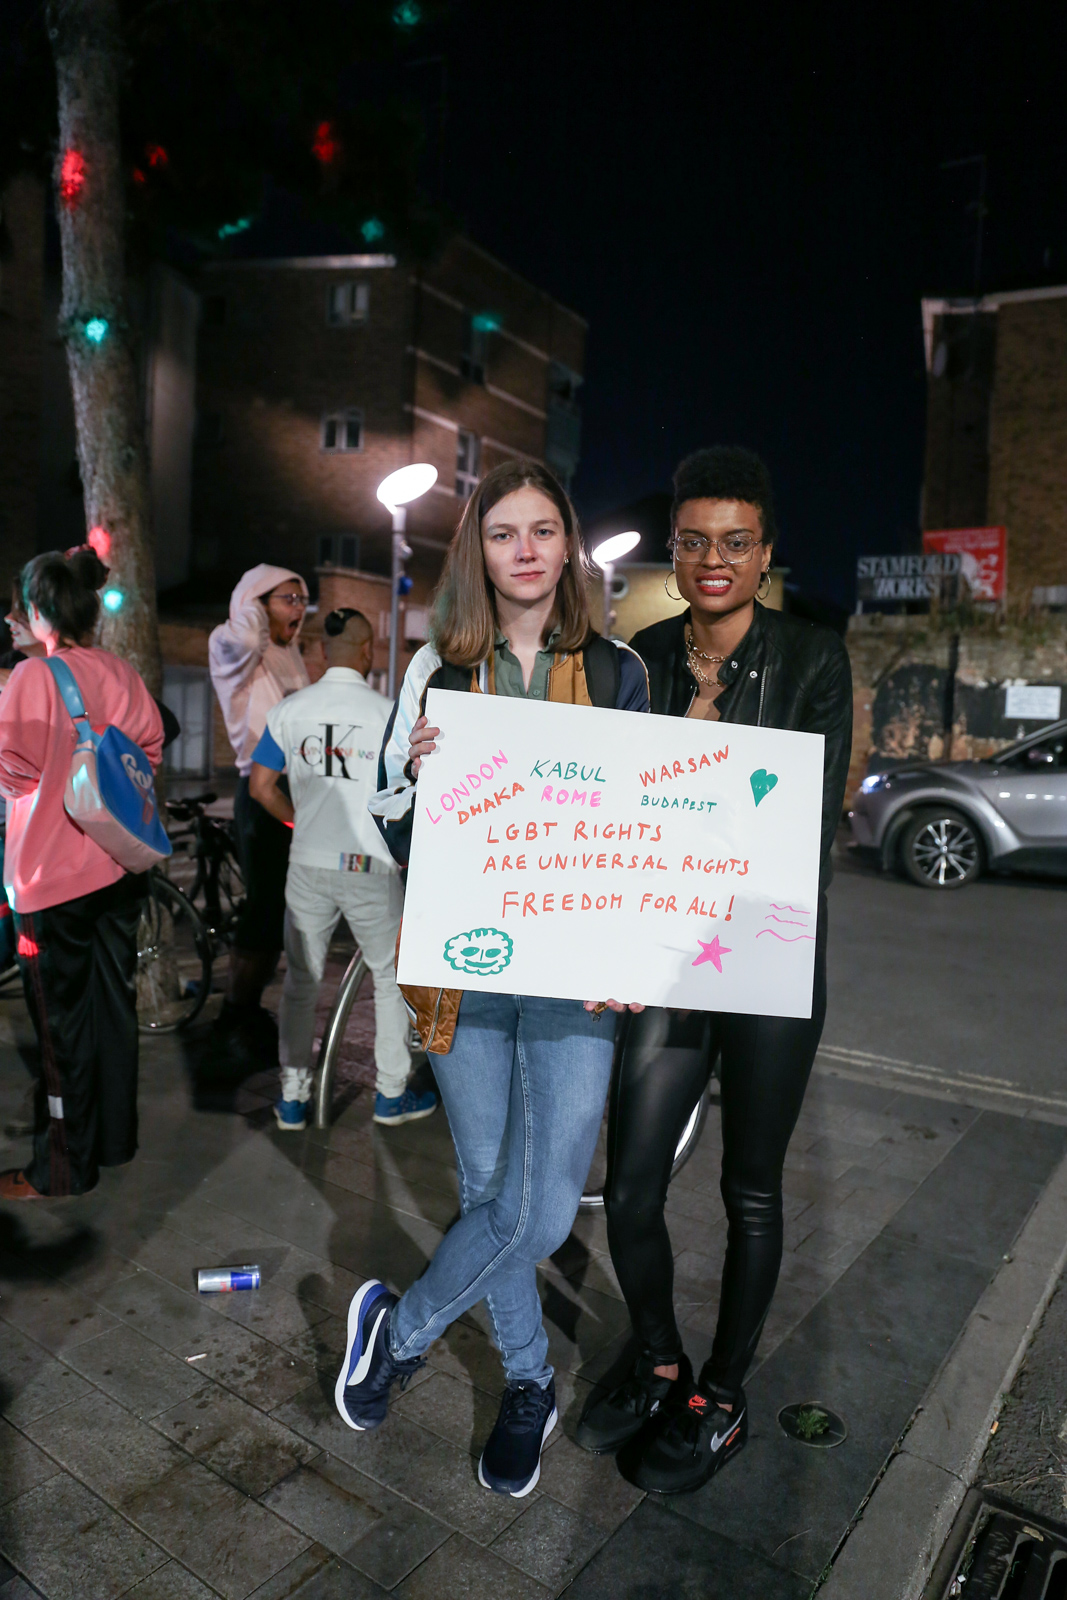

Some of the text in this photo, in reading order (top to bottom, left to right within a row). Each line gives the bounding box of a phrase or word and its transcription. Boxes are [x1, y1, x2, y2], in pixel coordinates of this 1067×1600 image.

[857, 555, 960, 578] STAMFORD
[873, 577, 940, 598] WORKS
[530, 759, 607, 783] KABUL
[639, 745, 730, 788] WARSAW
[426, 749, 509, 825] LONDON
[541, 785, 602, 808] ROME
[457, 782, 525, 825] DHAKA
[640, 795, 717, 813] BUDAPEST
[486, 820, 662, 844] LGBT RIGHTS
[482, 853, 750, 876] ARE UNIVERSAL RIGHTS
[501, 891, 735, 922] FREEDOM FOR ALL!
